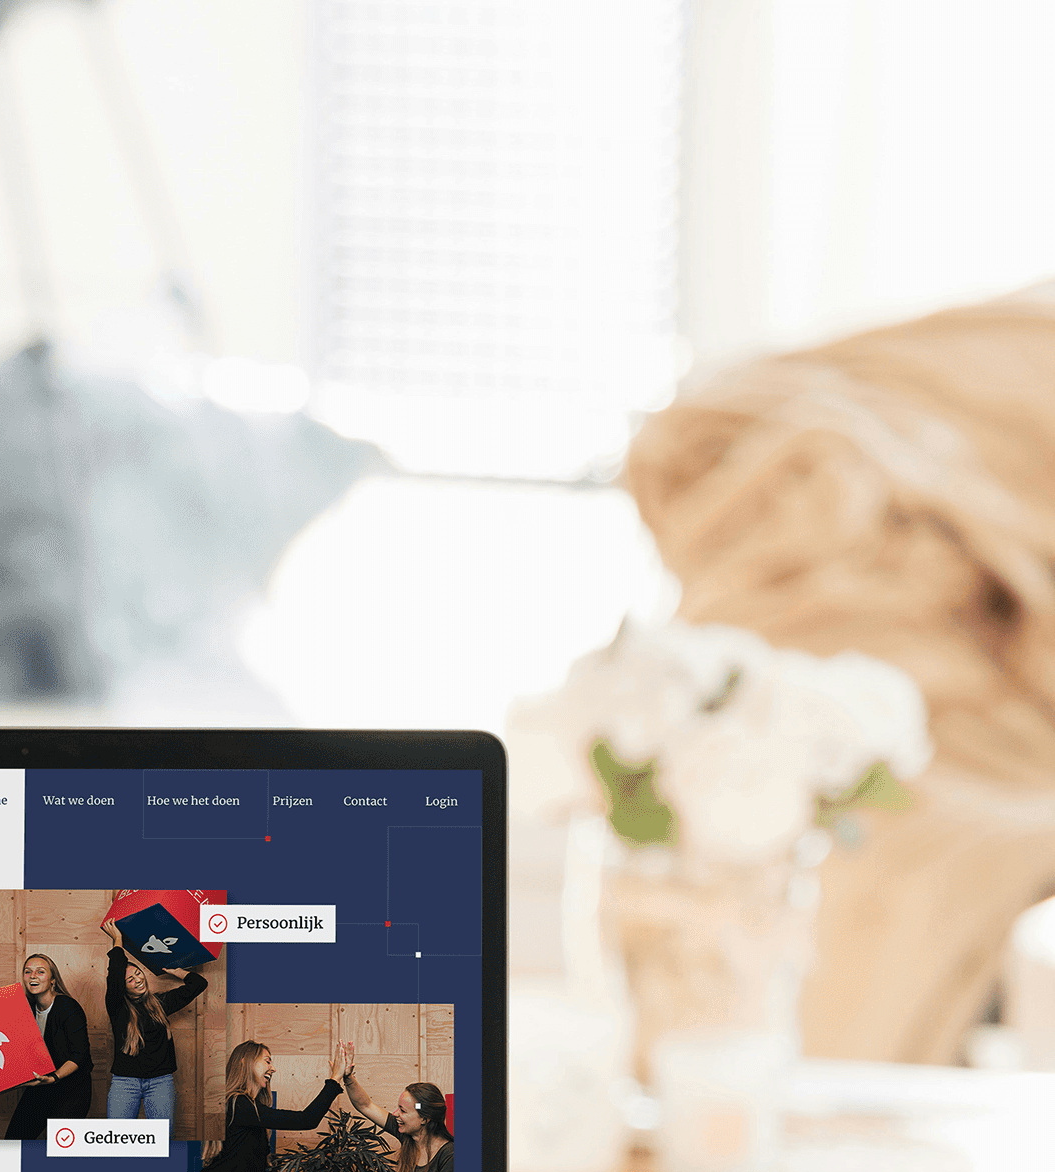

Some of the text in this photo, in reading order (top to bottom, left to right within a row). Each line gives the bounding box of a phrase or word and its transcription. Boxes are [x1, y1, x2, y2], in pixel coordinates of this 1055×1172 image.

[43, 796, 65, 805] Wat
[87, 795, 114, 805] doen
[148, 796, 169, 805] Hoe
[191, 796, 209, 805] het
[212, 796, 239, 805] doen
[273, 796, 313, 808] Prijzen
[344, 796, 387, 806] Contact
[426, 796, 458, 809] Login
[237, 916, 323, 932] Persoonlijk
[84, 1131, 155, 1144] Gedreven
